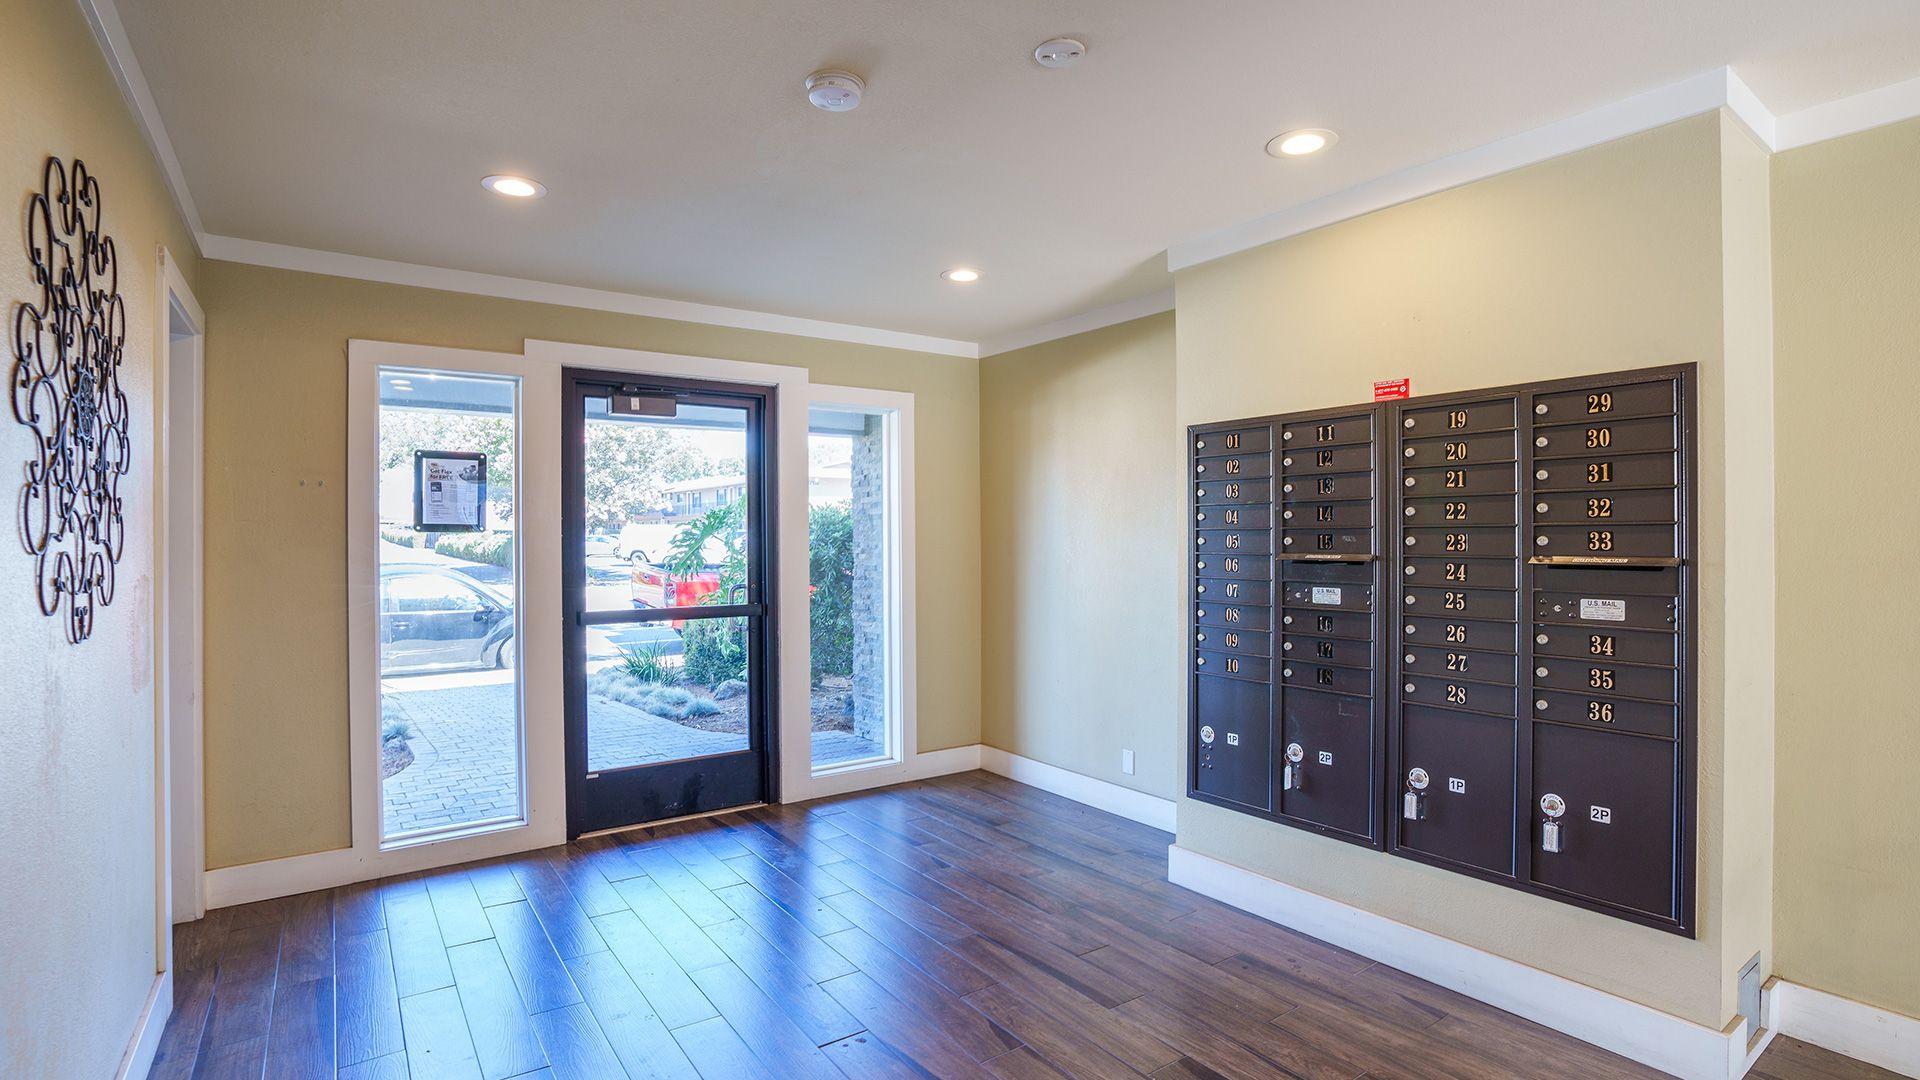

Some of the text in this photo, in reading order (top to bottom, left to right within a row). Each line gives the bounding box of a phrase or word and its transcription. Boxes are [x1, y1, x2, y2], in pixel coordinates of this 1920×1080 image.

[1588, 393, 1612, 414] 29
[1450, 411, 1466, 428] 19
[1318, 424, 1334, 441] 11
[1587, 428, 1611, 448] 30
[1226, 434, 1239, 448] 01
[1318, 450, 1333, 466] 12
[1446, 442, 1466, 460] 20
[1226, 459, 1239, 474] 02
[1588, 463, 1611, 483] 31
[1319, 478, 1334, 494] 13
[1446, 471, 1465, 487] 21
[1226, 484, 1239, 498] 03
[1318, 507, 1333, 521] 14
[1446, 502, 1466, 519] 22
[1588, 499, 1611, 517] 32
[1226, 509, 1239, 524] 04
[1226, 534, 1239, 549] 05
[1319, 534, 1333, 550] 15
[1446, 534, 1466, 551] 23
[1589, 532, 1612, 550] 33
[1225, 558, 1238, 572] 06
[1446, 563, 1466, 581] 24
[1226, 583, 1239, 598] 07
[1445, 592, 1465, 610] 25
[1226, 608, 1239, 622] 08
[1226, 633, 1238, 648] 09
[1447, 625, 1465, 643] 26
[1591, 635, 1614, 656] 34
[1226, 658, 1239, 673] 10
[1447, 653, 1467, 672] 27
[1319, 668, 1333, 685] 18
[1590, 669, 1613, 690] 35
[1447, 685, 1466, 704] 28
[1589, 702, 1612, 723] 36
[1228, 735, 1238, 744] 1P
[1320, 753, 1331, 763] 2P
[1450, 780, 1464, 791] 1P
[1592, 808, 1609, 820] 2P
